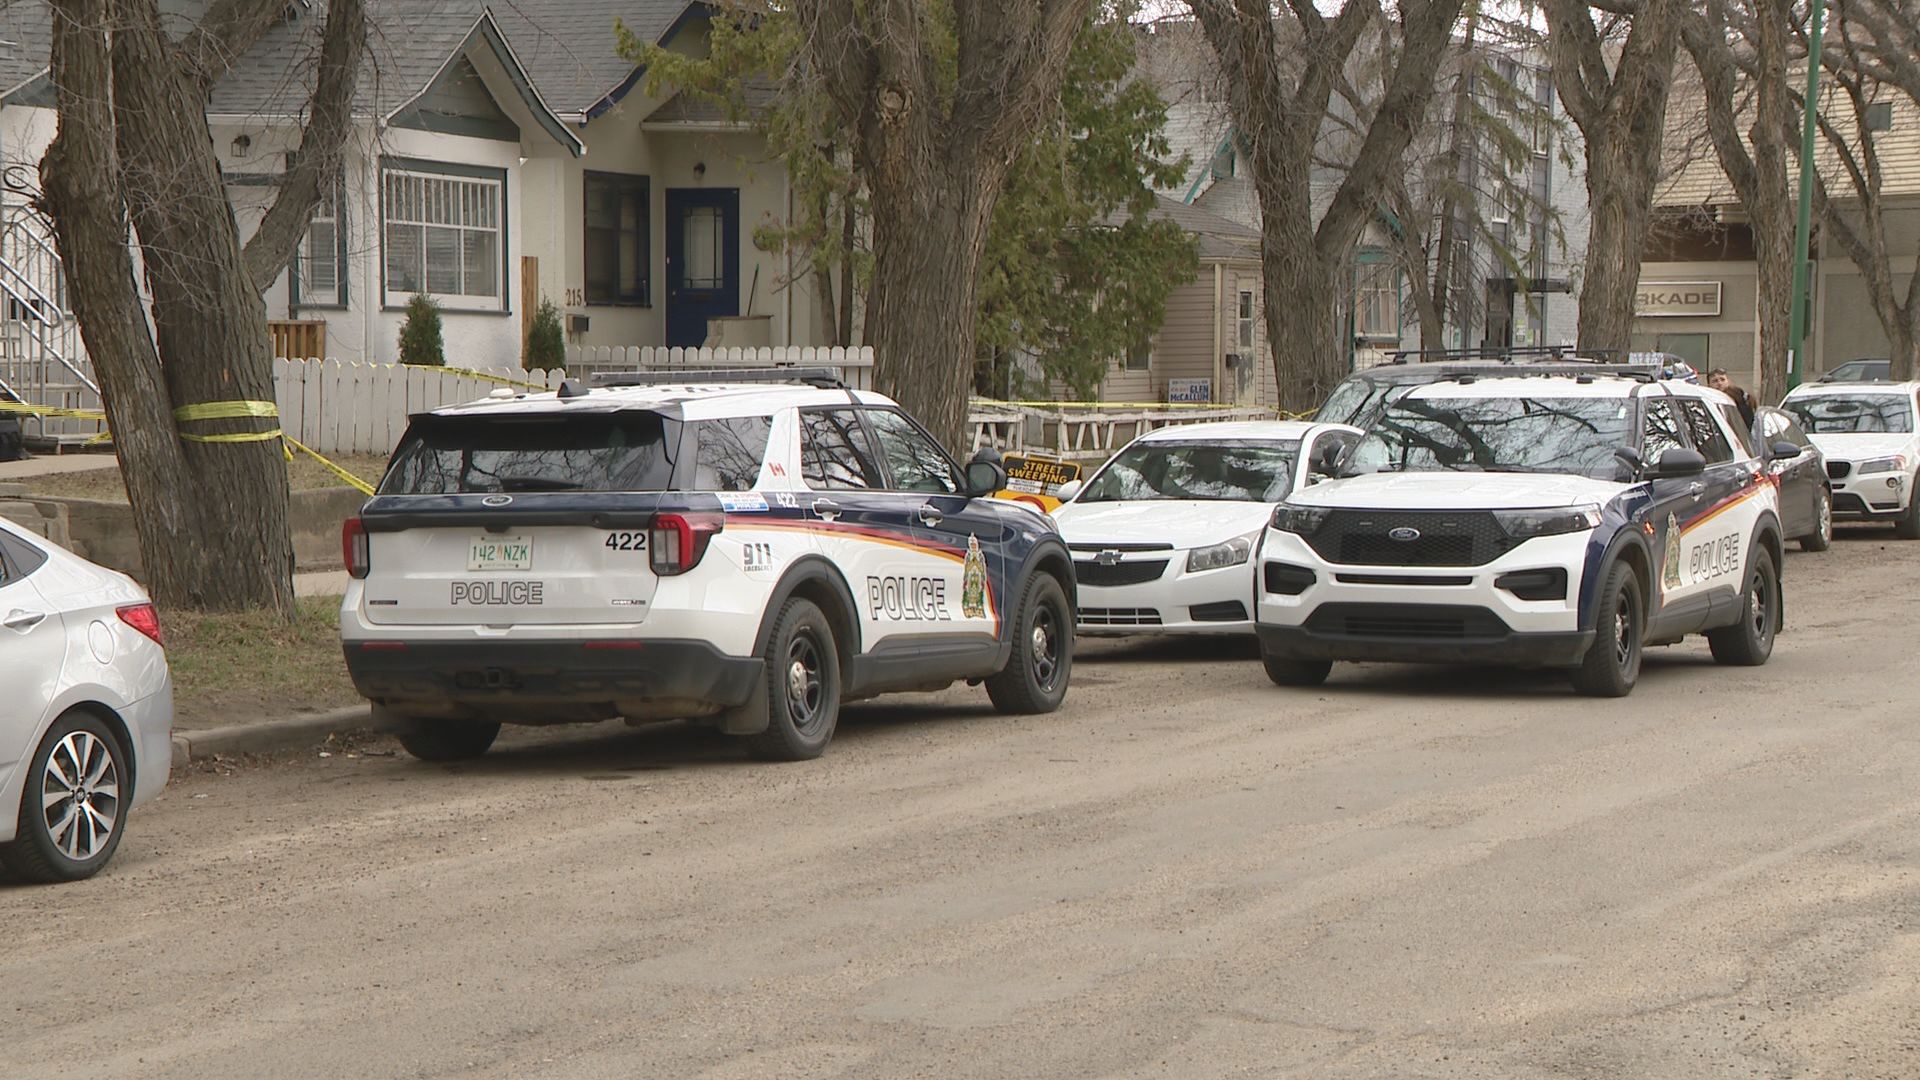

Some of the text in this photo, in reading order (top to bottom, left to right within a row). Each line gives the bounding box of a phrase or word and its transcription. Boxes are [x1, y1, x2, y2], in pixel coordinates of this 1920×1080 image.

[565, 289, 582, 306] 215
[1007, 467, 1068, 484] SWEEPING
[1023, 461, 1063, 474] STREET
[775, 492, 800, 508] 422
[605, 532, 647, 551] 422
[473, 545, 529, 561] 142 NZK
[743, 543, 772, 565] 911
[1690, 532, 1740, 584] POLICE
[451, 581, 543, 605] POLICE
[867, 575, 951, 621] POLICE
